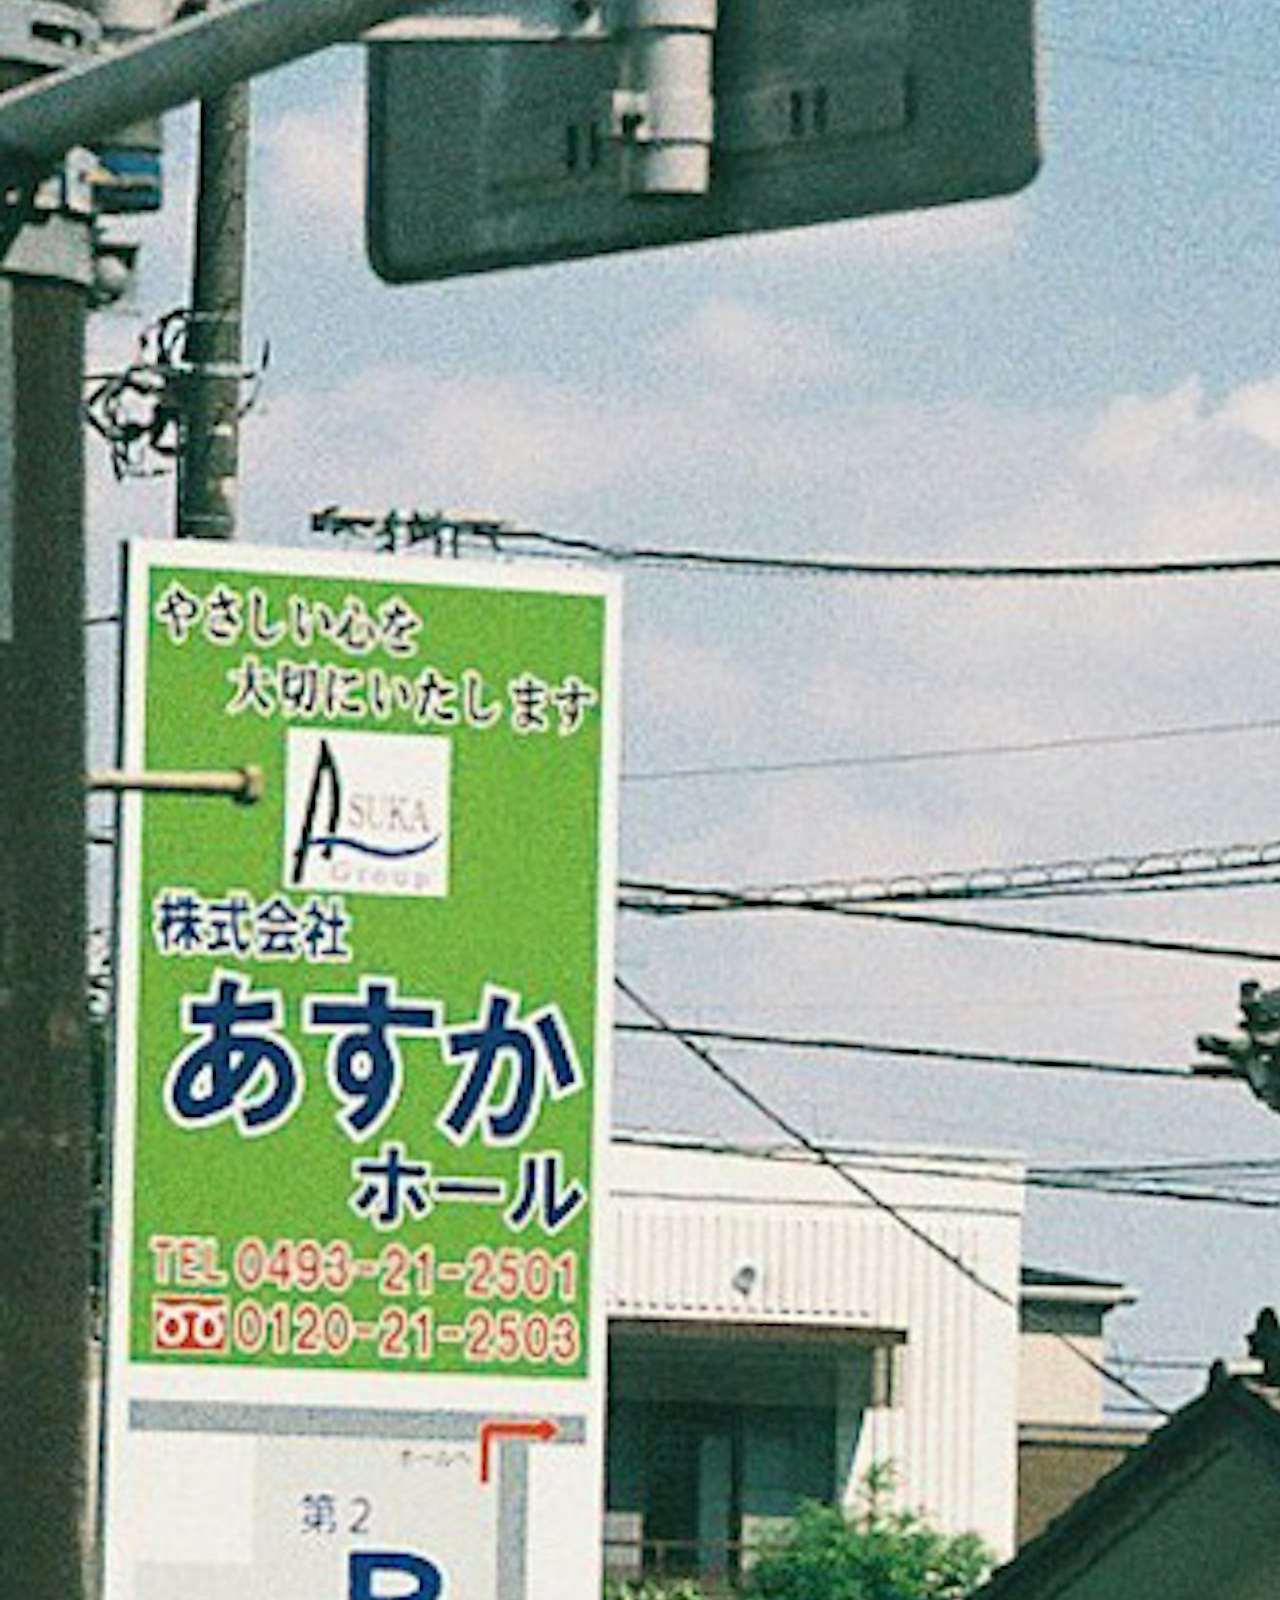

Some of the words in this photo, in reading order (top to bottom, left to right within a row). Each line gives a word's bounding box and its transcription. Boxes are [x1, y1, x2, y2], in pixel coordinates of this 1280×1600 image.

[160, 587, 420, 653] やさしい心を
[230, 661, 595, 732] 大切にいたします
[157, 894, 349, 958] 株式会社
[167, 974, 582, 1141] あすか
[354, 1147, 584, 1227] ホール
[151, 1239, 225, 1282] TEL
[234, 1241, 578, 1298] 0493-21-2501
[234, 1304, 580, 1360] 0120-21-2503
